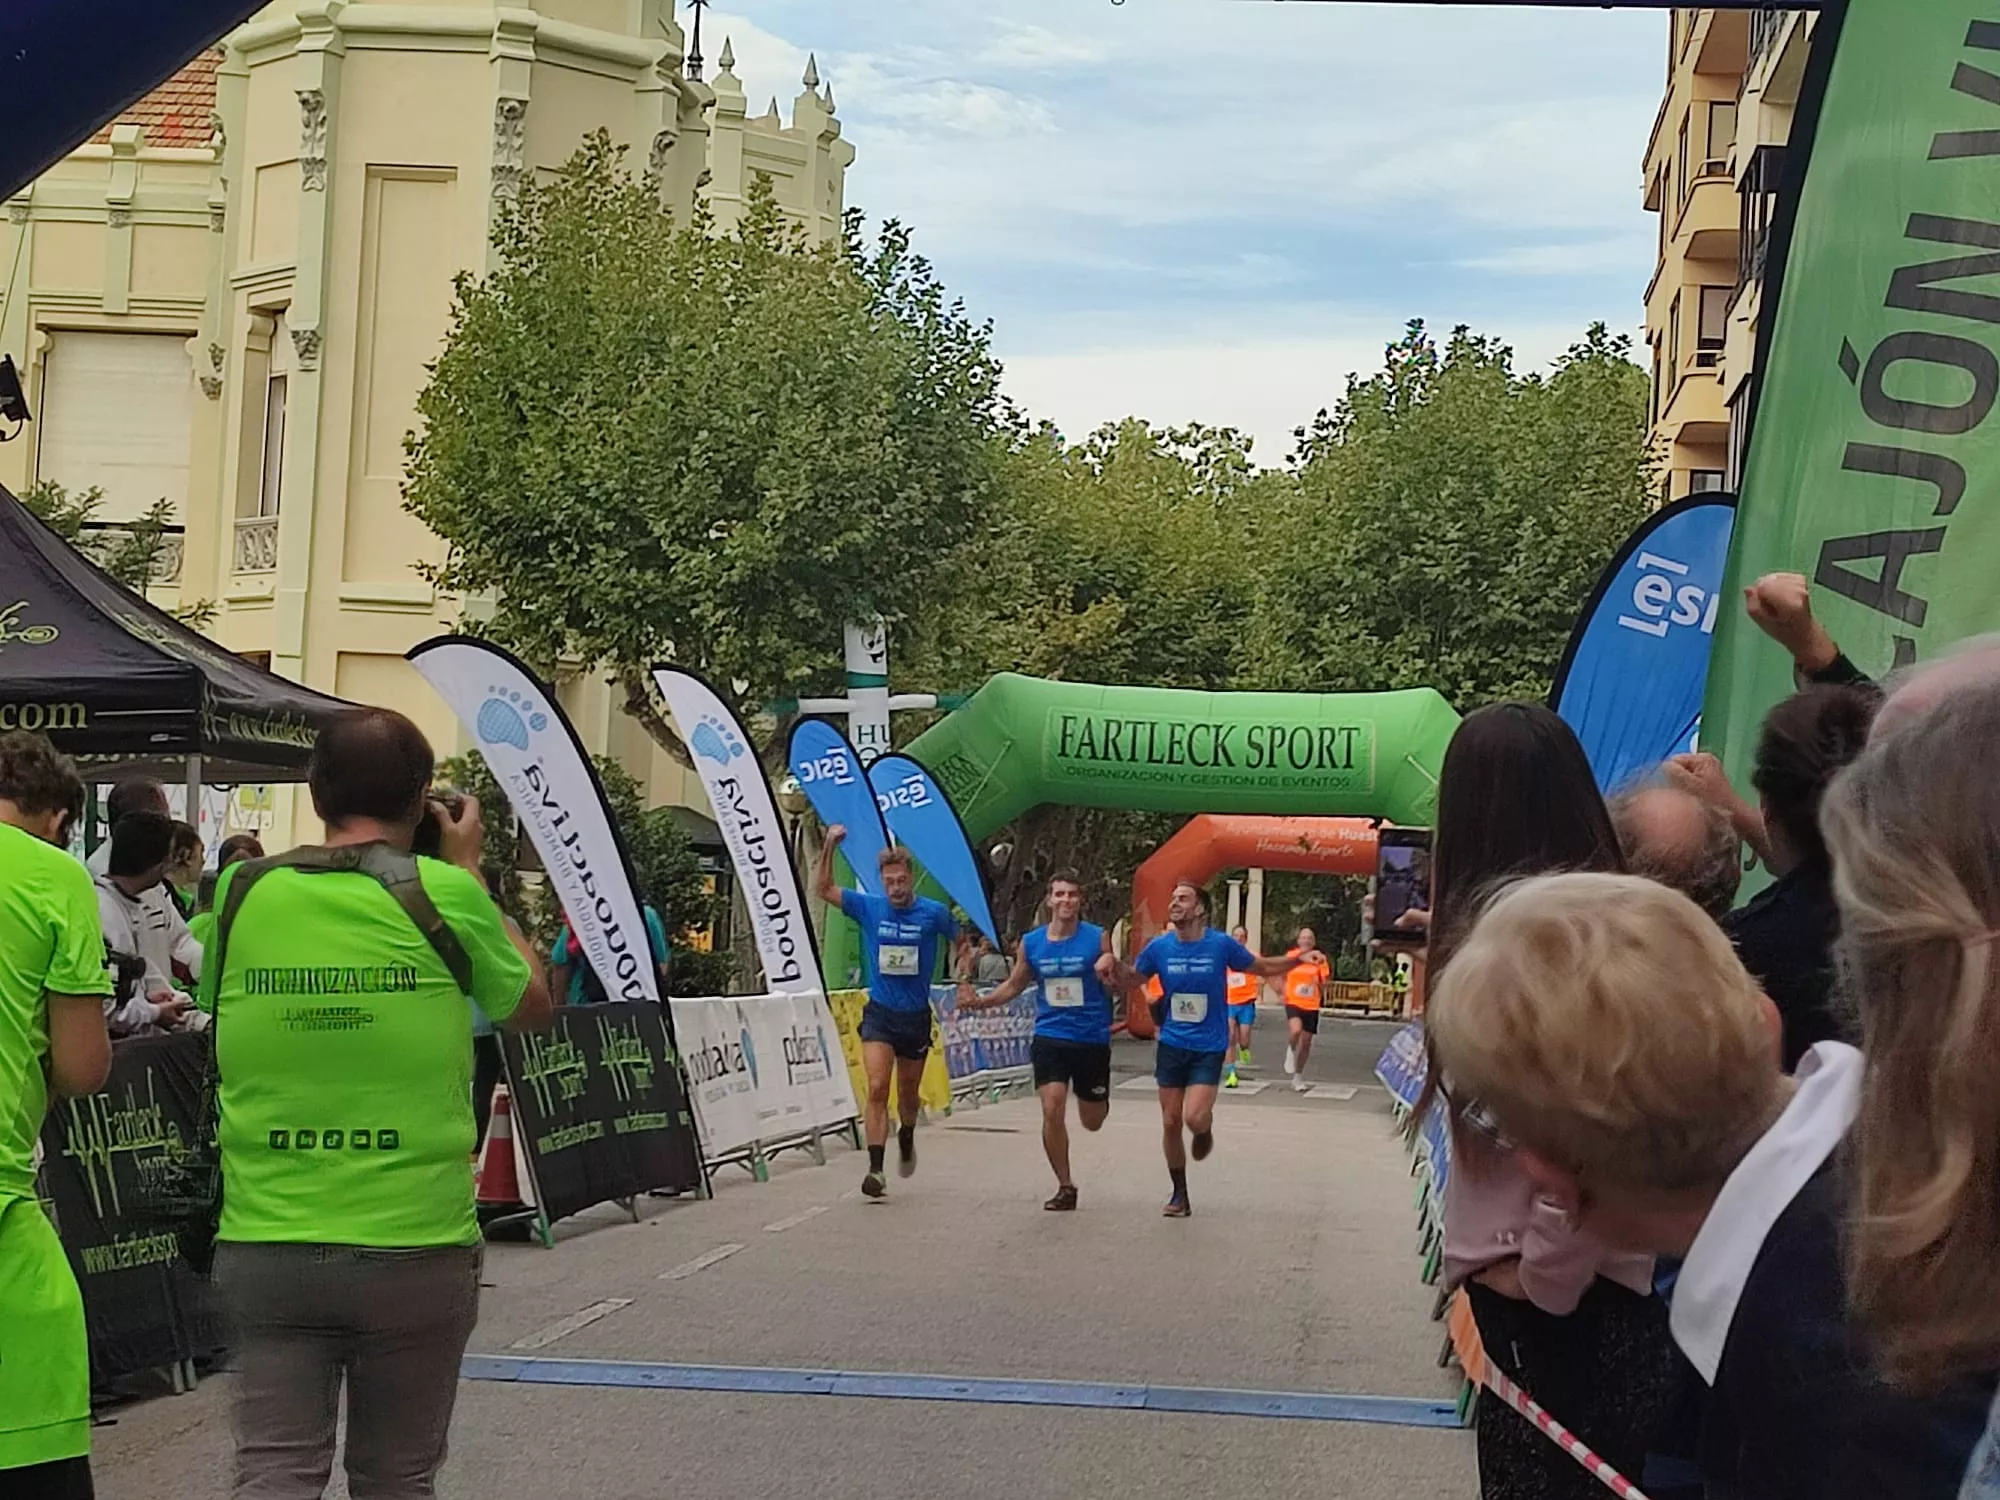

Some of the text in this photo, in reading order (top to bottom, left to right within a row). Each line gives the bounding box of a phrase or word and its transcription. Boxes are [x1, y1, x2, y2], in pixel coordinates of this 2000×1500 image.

[1814, 213, 2000, 668] AJÓN
[1057, 715, 1361, 770] FARTLECK SPORT
[1258, 775, 1281, 787] DE
[1282, 776, 1350, 788] EVENTOS
